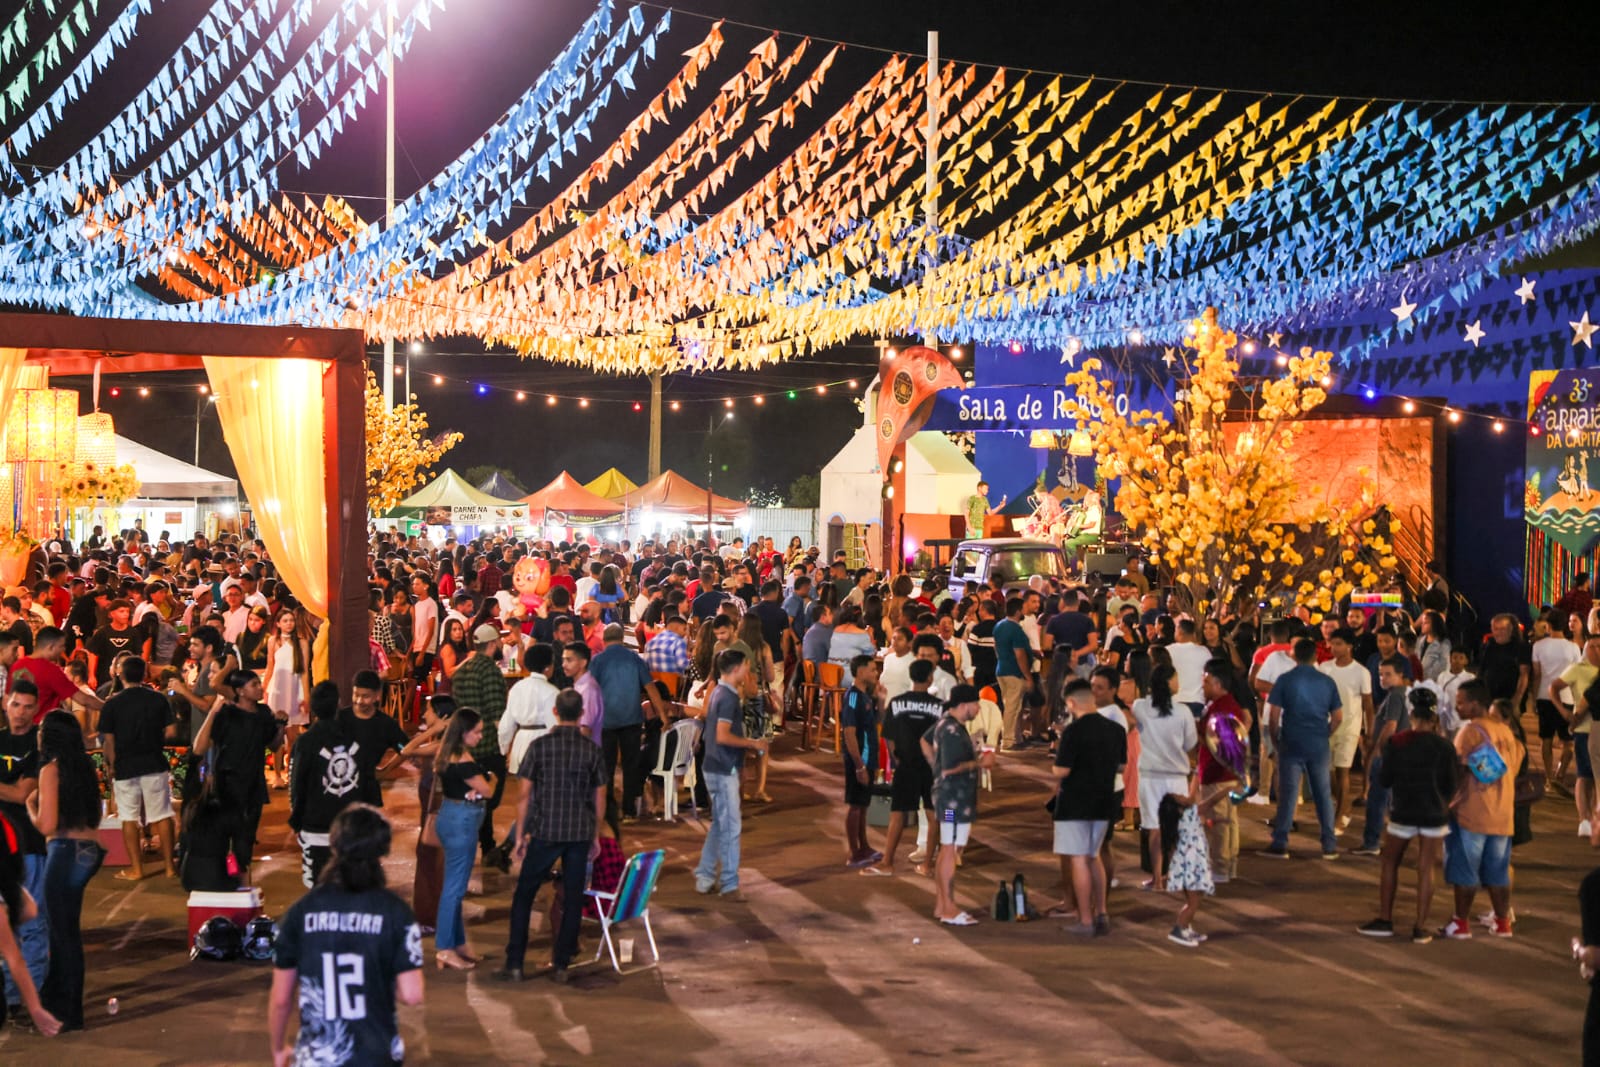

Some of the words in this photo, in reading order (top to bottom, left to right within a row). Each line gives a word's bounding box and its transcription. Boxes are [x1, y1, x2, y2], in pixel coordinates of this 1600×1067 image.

[1017, 394, 1043, 420] de
[1546, 433, 1562, 449] DA
[891, 700, 943, 718] BALENCIAGA
[322, 952, 367, 1021] 12
